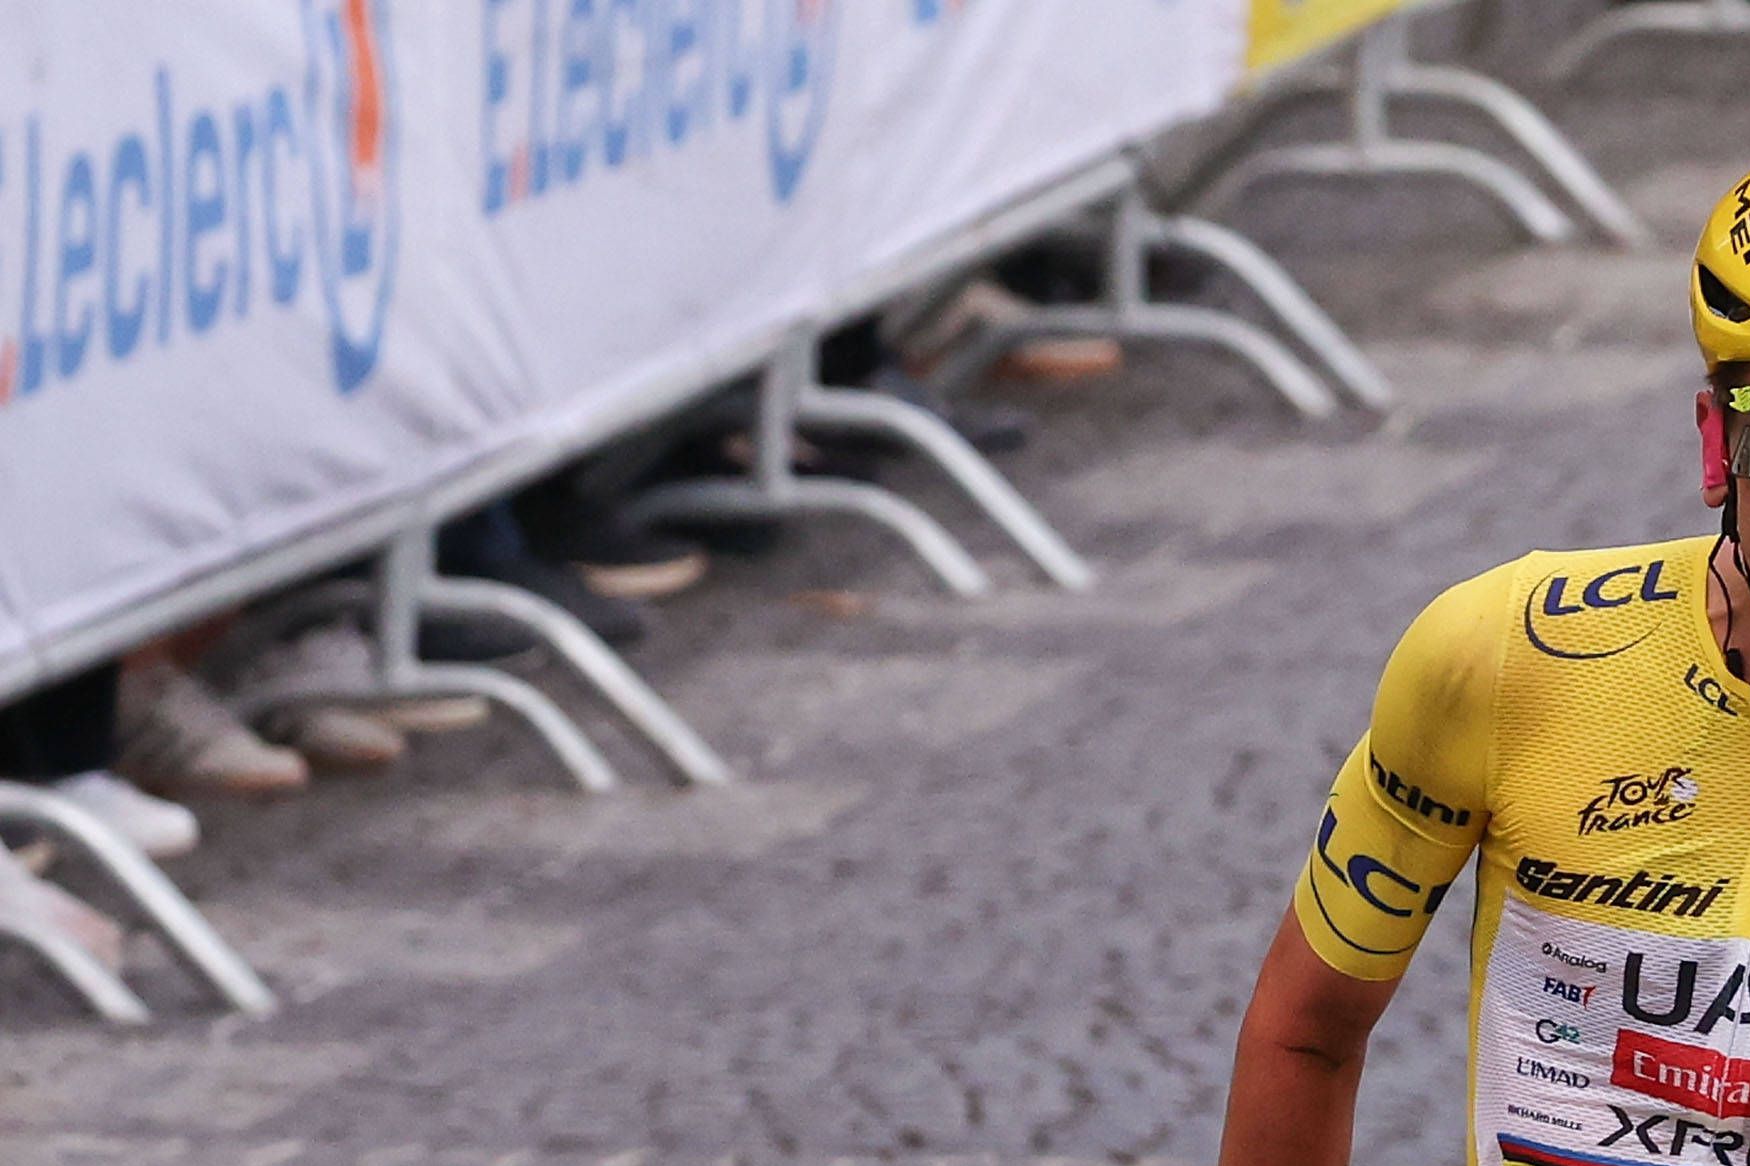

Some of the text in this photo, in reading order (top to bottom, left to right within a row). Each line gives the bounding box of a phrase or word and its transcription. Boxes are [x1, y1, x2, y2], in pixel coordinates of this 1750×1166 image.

[0, 62, 303, 402] .Leclerc
[1543, 560, 1678, 616] LCL
[1683, 663, 1738, 716] LCL
[1370, 751, 1470, 827] ntini
[1552, 947, 1608, 973] Analog
